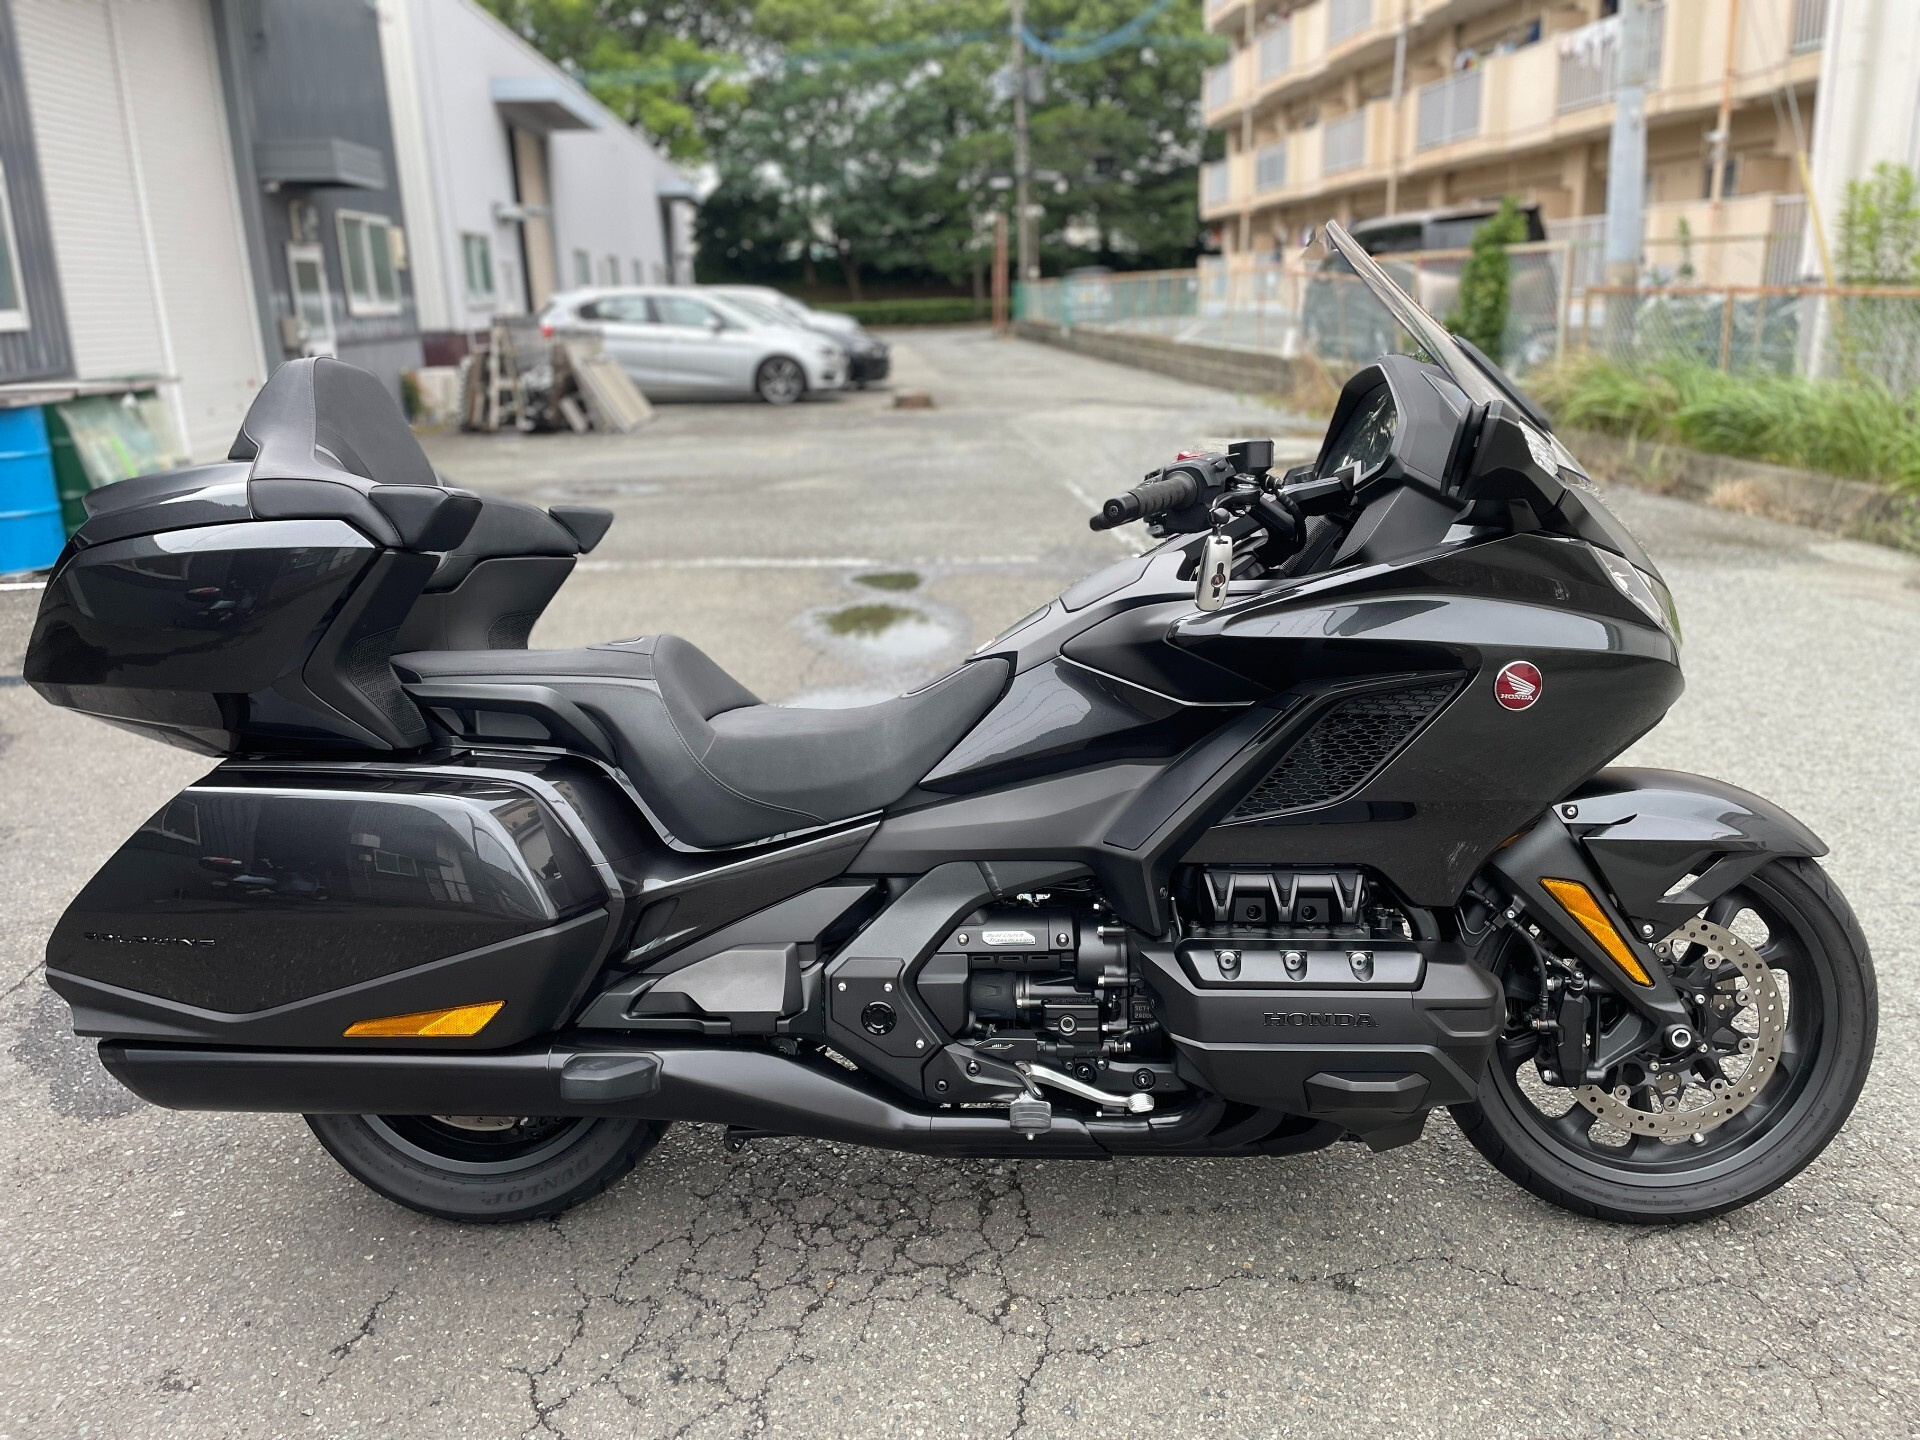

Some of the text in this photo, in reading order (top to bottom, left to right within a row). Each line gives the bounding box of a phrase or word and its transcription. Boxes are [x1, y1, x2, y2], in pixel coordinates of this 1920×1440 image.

[1500, 693, 1534, 701] HONDA
[1263, 1012, 1380, 1027] HONDA
[485, 1154, 593, 1207] DUNLOP
